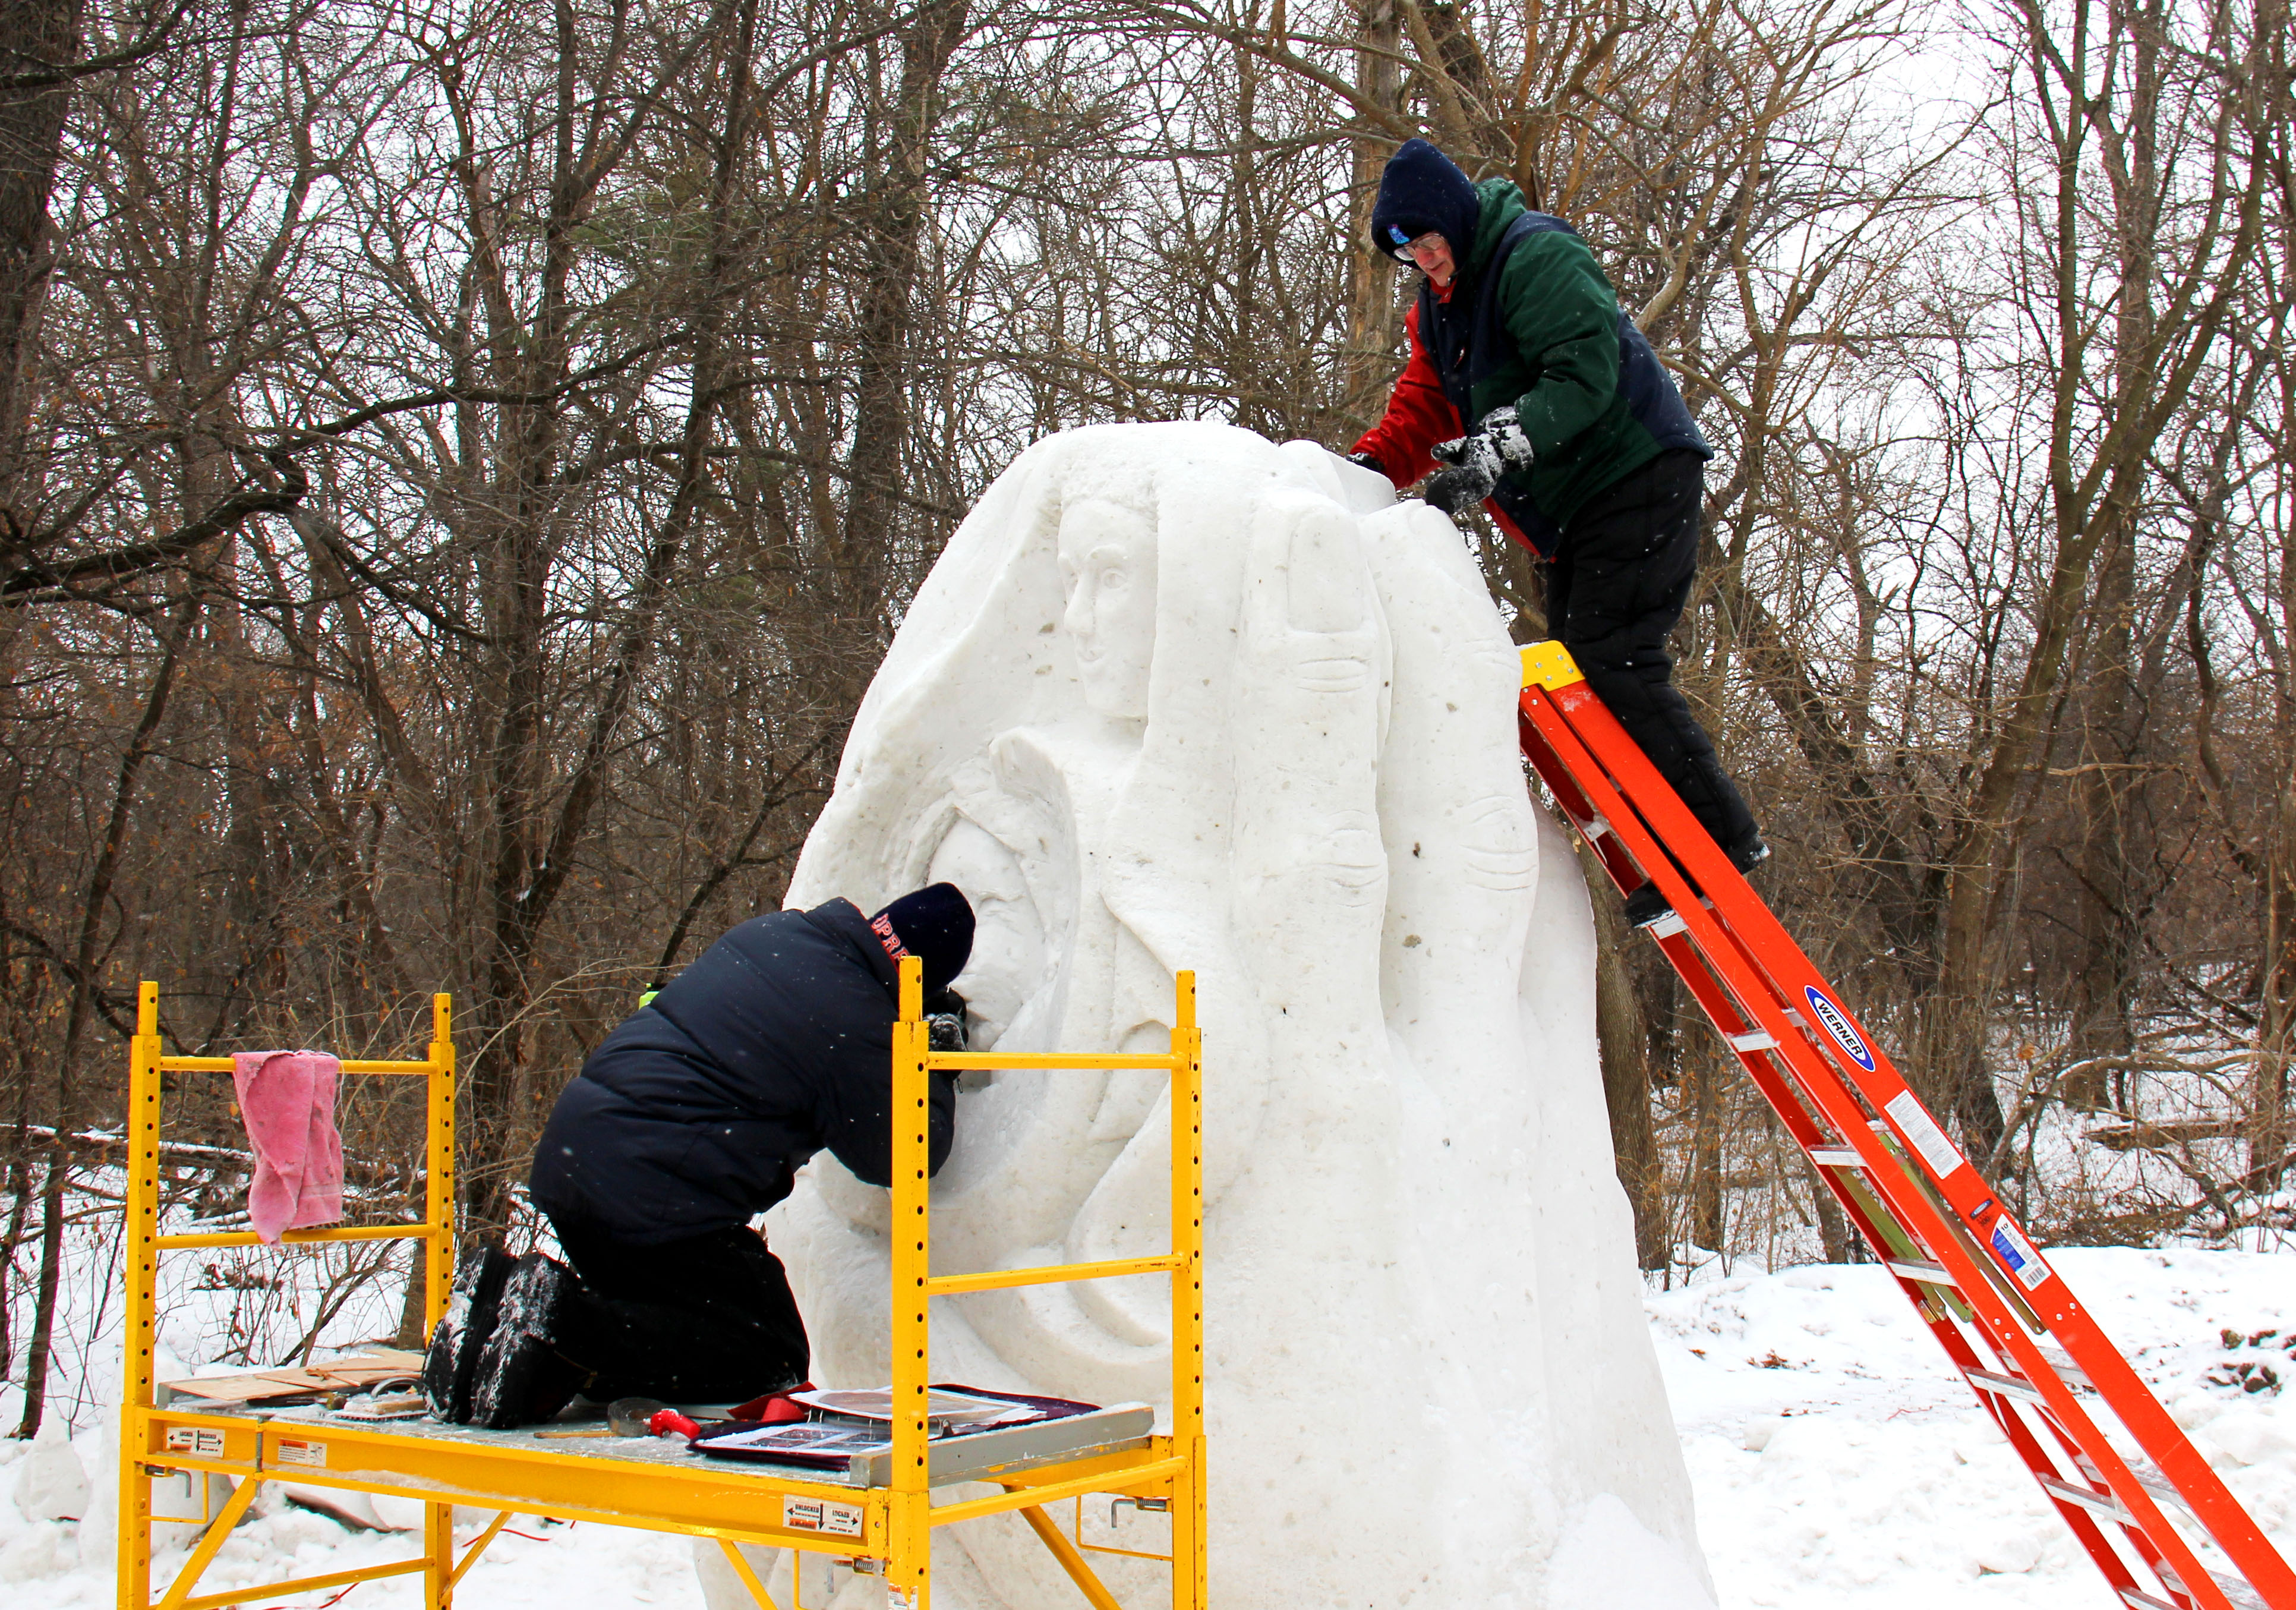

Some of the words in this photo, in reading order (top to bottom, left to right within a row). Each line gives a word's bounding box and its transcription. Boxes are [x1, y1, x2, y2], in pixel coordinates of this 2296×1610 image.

[1818, 1003, 1862, 1055] WERNER
[795, 1504, 819, 1513] UNLOCKED
[832, 1510, 850, 1518] LOCKED
